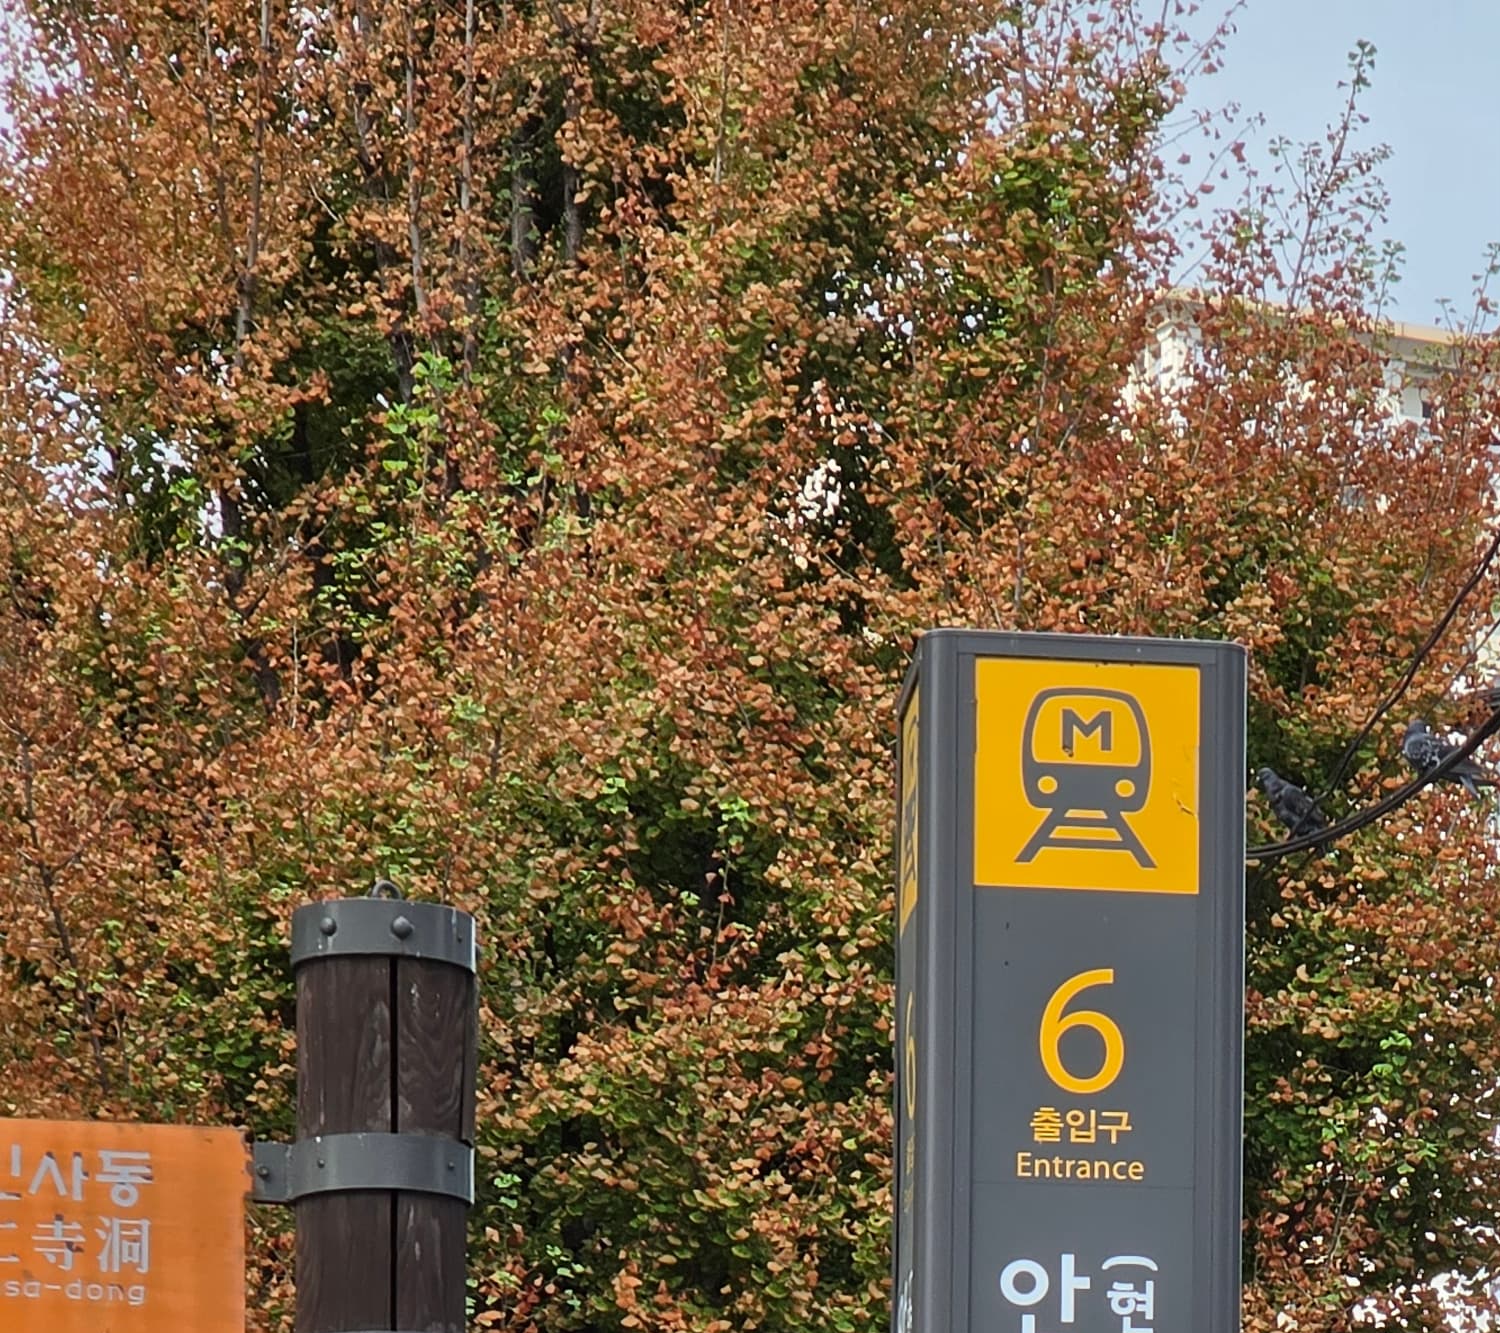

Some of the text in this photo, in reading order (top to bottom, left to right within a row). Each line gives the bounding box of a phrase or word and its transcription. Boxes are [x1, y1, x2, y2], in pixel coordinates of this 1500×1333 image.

[1039, 968, 1125, 1094] 6
[1029, 1108, 1132, 1145] 출입구
[1015, 1151, 1145, 1181] Entrance
